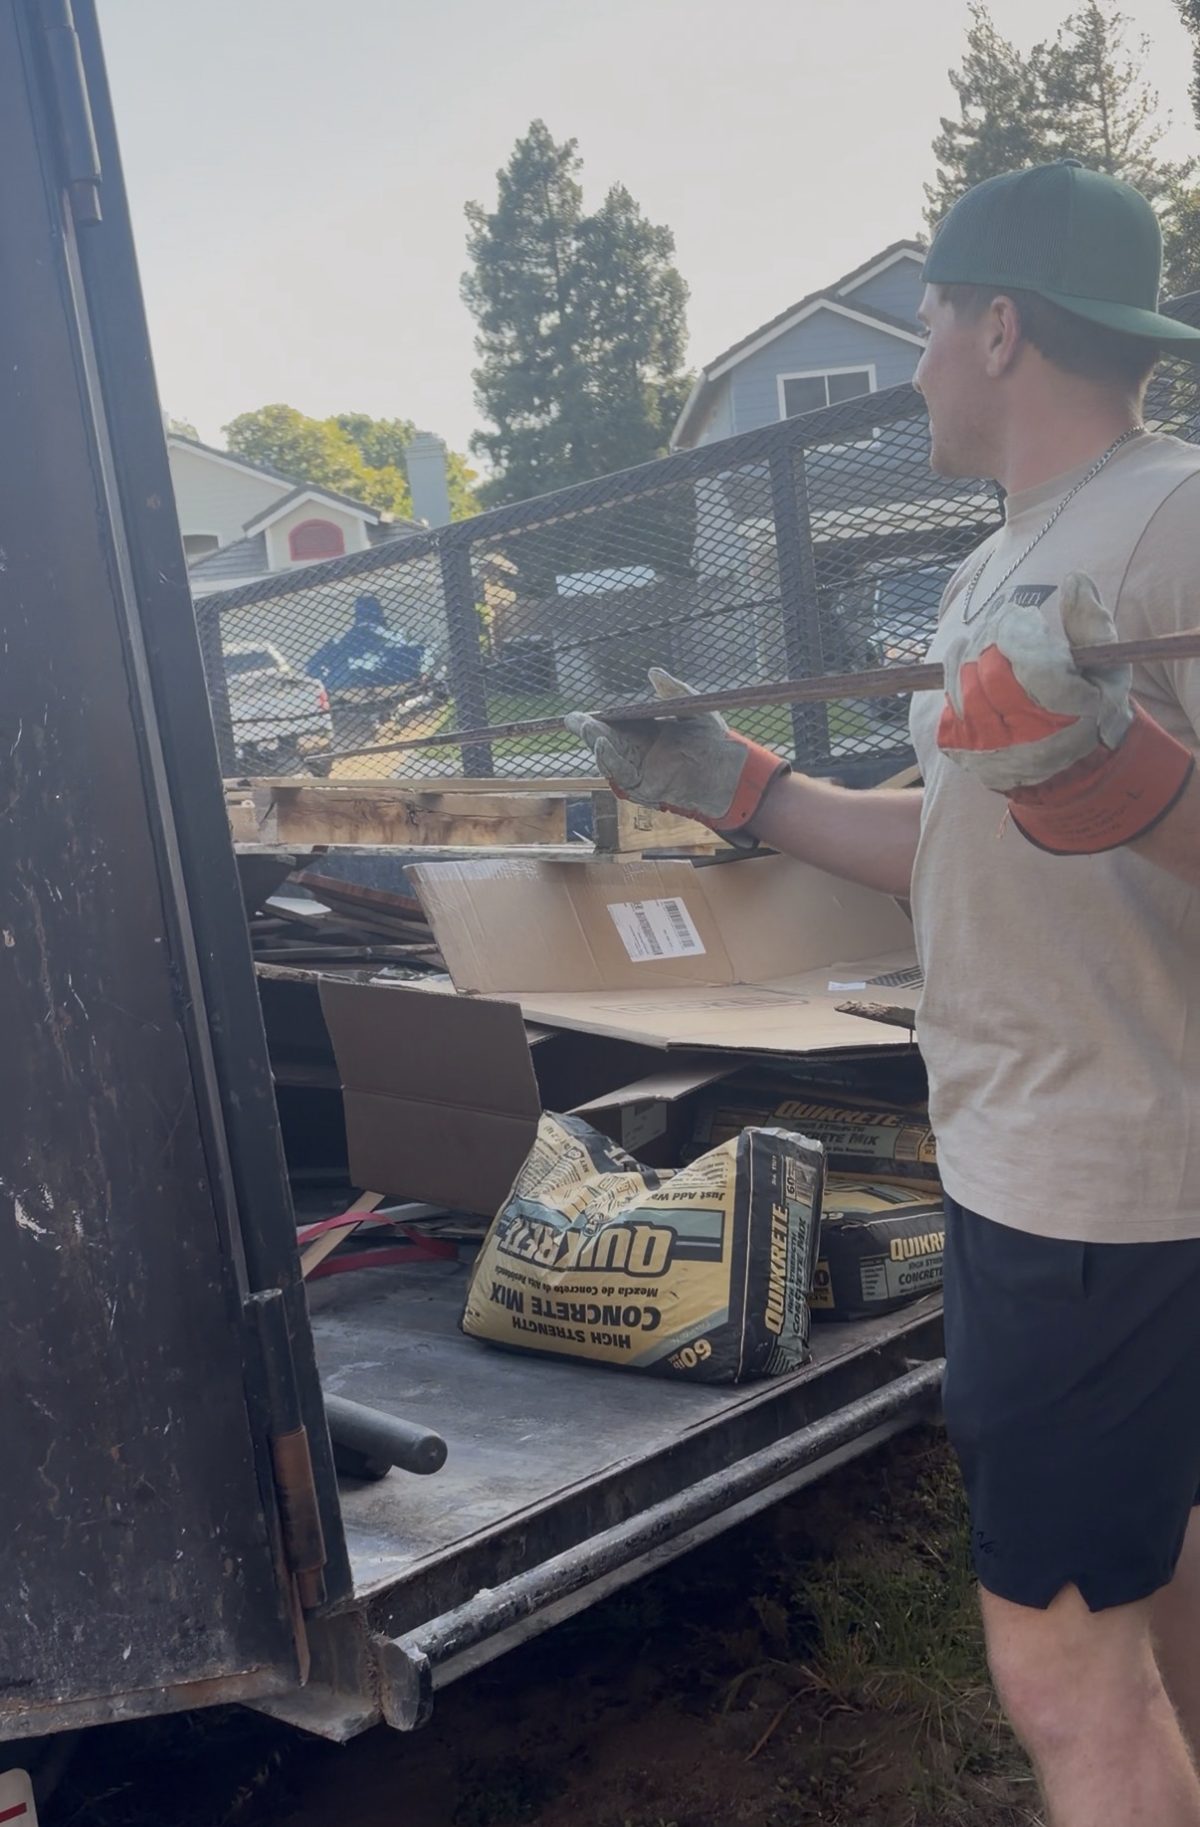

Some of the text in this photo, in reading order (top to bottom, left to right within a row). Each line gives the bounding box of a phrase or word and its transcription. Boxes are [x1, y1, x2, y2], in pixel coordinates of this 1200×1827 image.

[774, 1101, 899, 1127] QUIKRETE
[672, 1191, 697, 1200] Add
[701, 1191, 726, 1201] Just
[499, 1217, 674, 1275] QUIKRETE
[890, 1231, 946, 1261] QUIKRE
[764, 1202, 789, 1336] QUIKRETE
[554, 1285, 598, 1296] Concreto
[601, 1286, 615, 1297] de
[618, 1286, 659, 1298] Mezcla
[489, 1282, 662, 1332] CONCRETE MIX
[511, 1316, 631, 1350] HIGH STRENGTH
